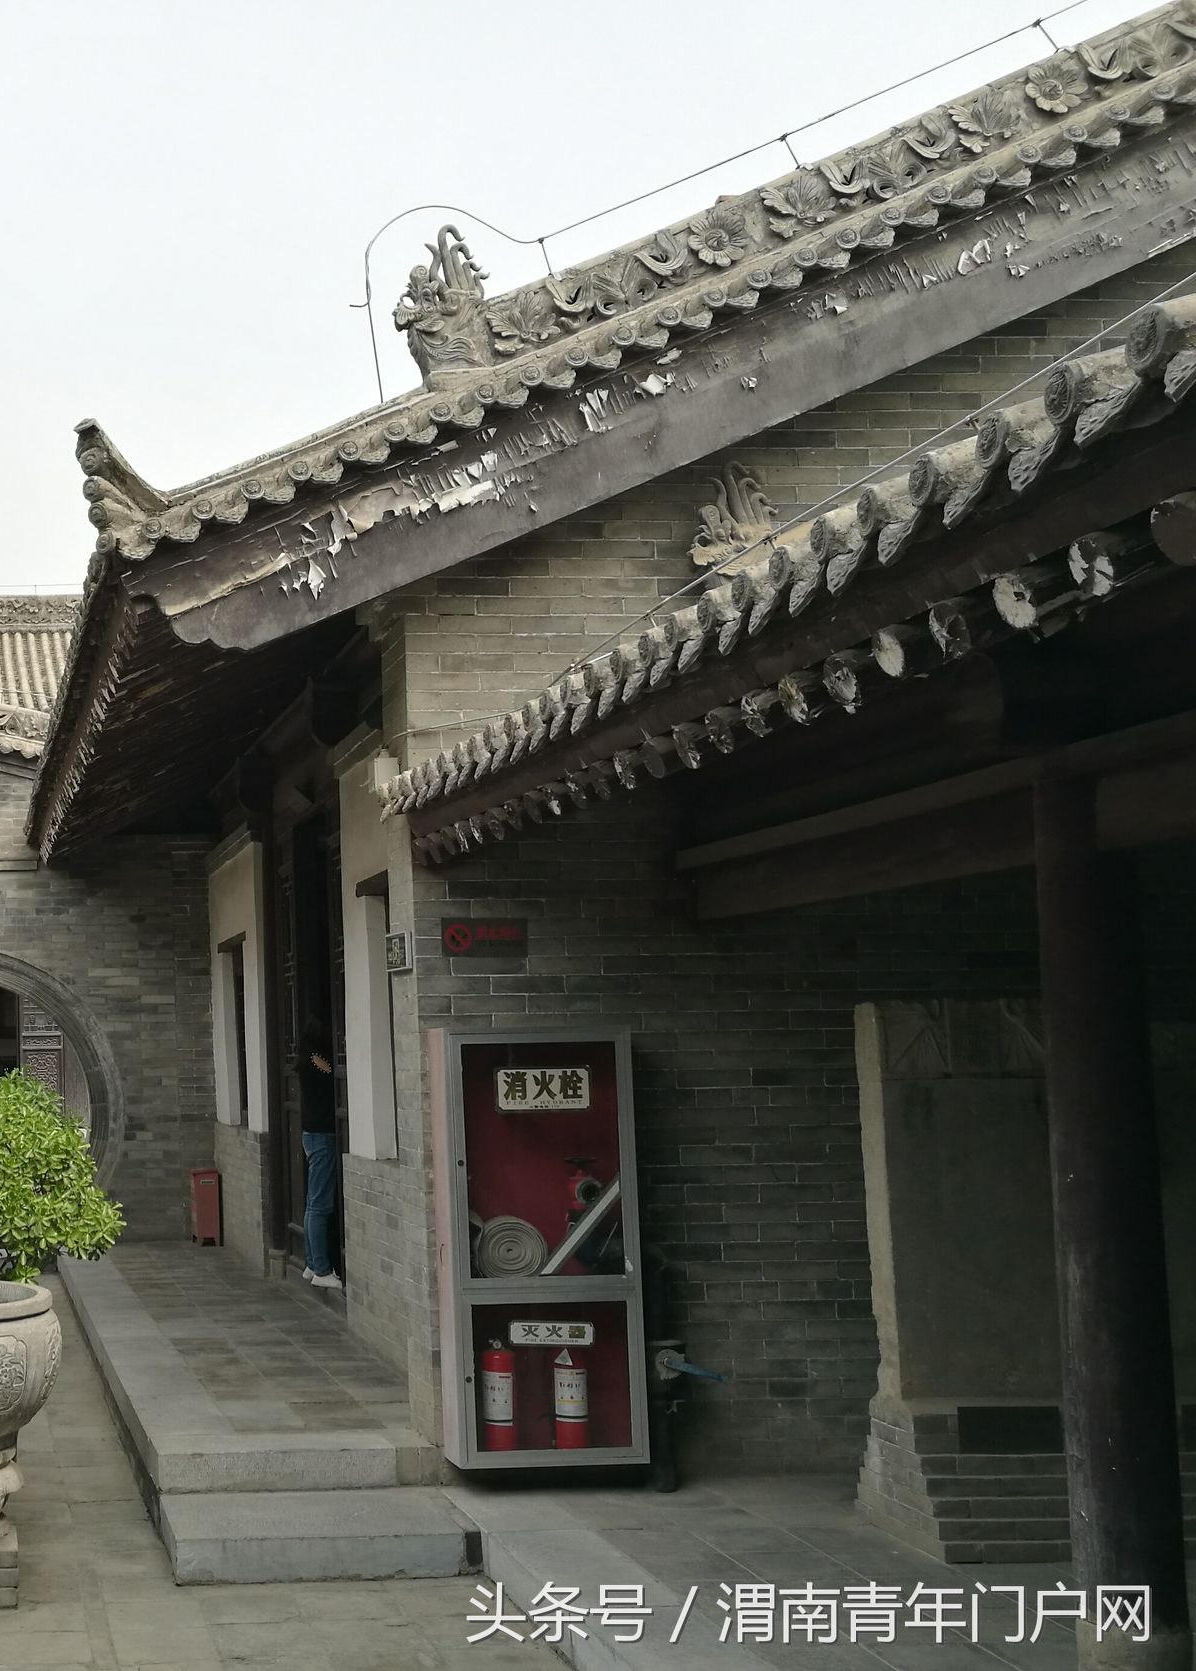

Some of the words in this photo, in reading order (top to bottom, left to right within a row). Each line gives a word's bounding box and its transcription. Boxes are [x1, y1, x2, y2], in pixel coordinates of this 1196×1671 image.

[503, 1070, 584, 1100] 消火栓
[521, 1325, 586, 1338] 灭火器
